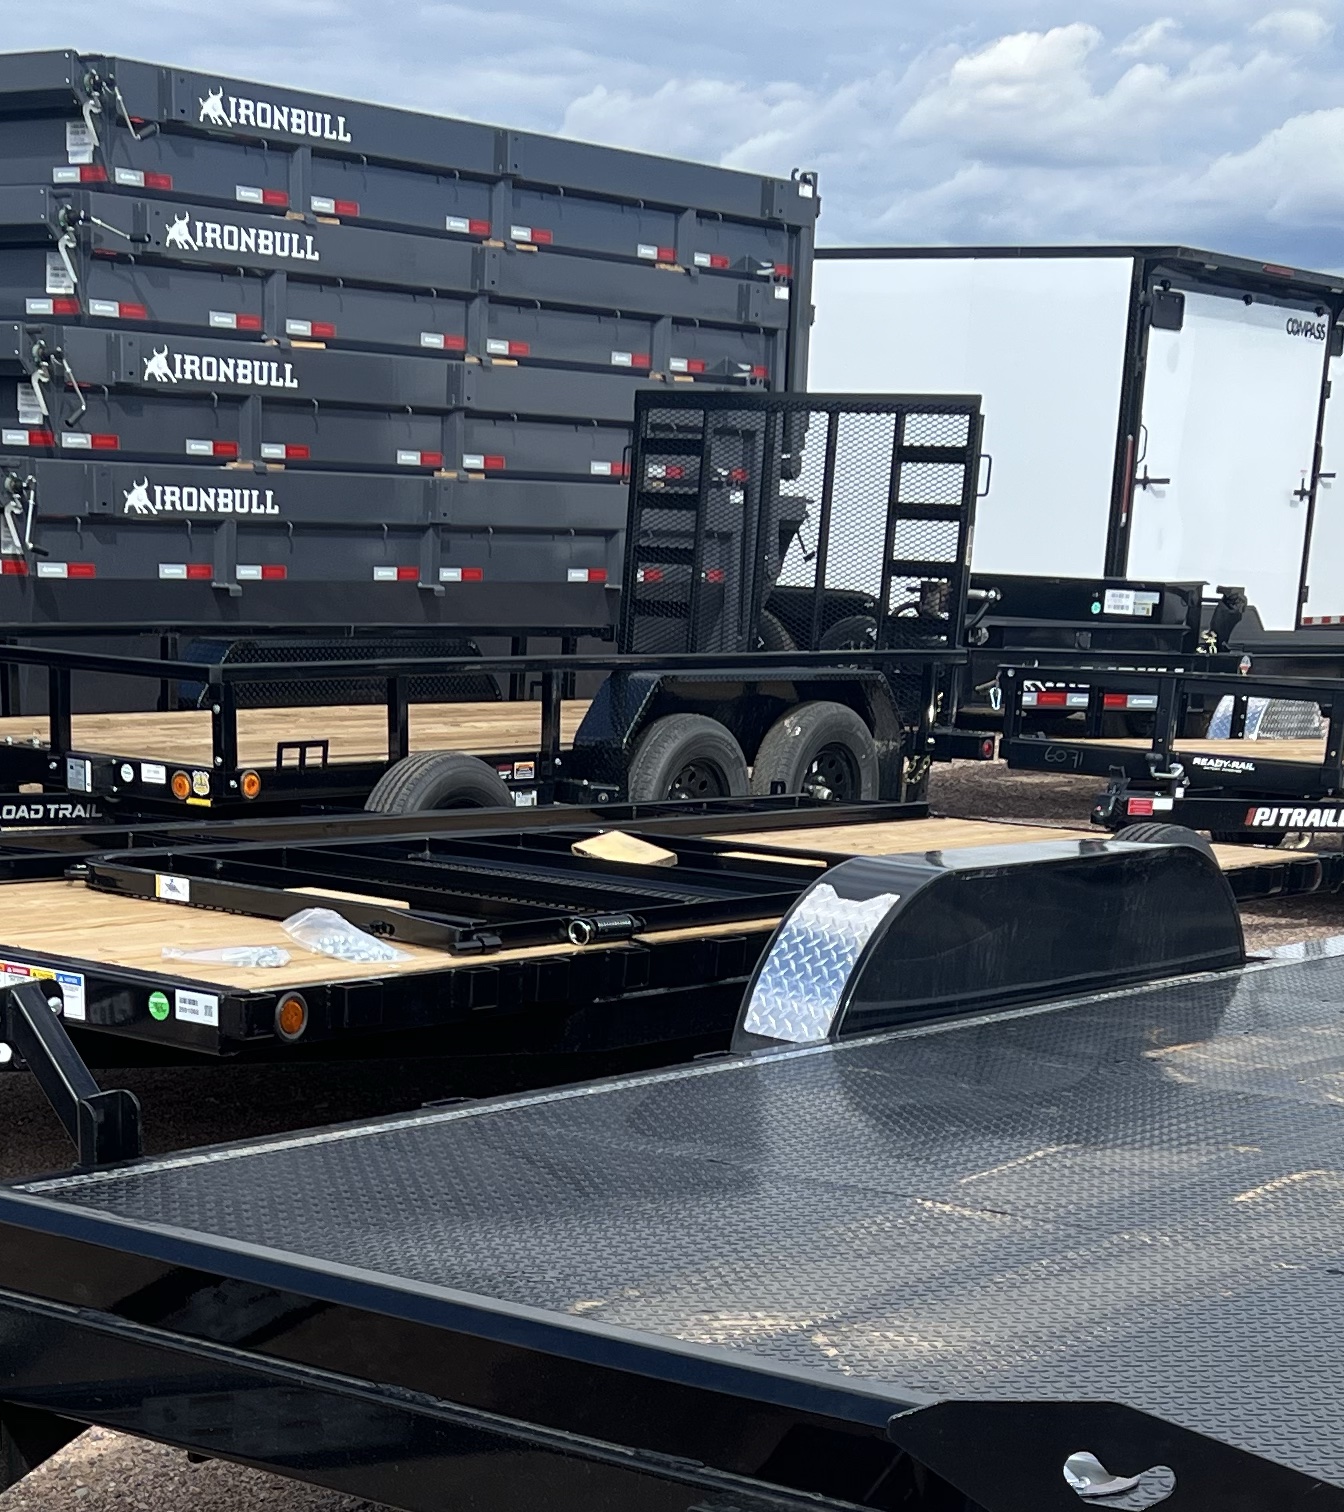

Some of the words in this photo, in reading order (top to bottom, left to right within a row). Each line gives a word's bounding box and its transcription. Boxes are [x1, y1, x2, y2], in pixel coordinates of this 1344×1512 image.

[228, 96, 351, 143] IRONBULL
[195, 221, 320, 261] IRONBULL
[1286, 317, 1326, 341] COMPASS
[173, 353, 298, 388] IRONBULL
[154, 485, 279, 514] IRONBULL
[46, 803, 103, 818] TRAIL
[1253, 808, 1280, 828] PJ
